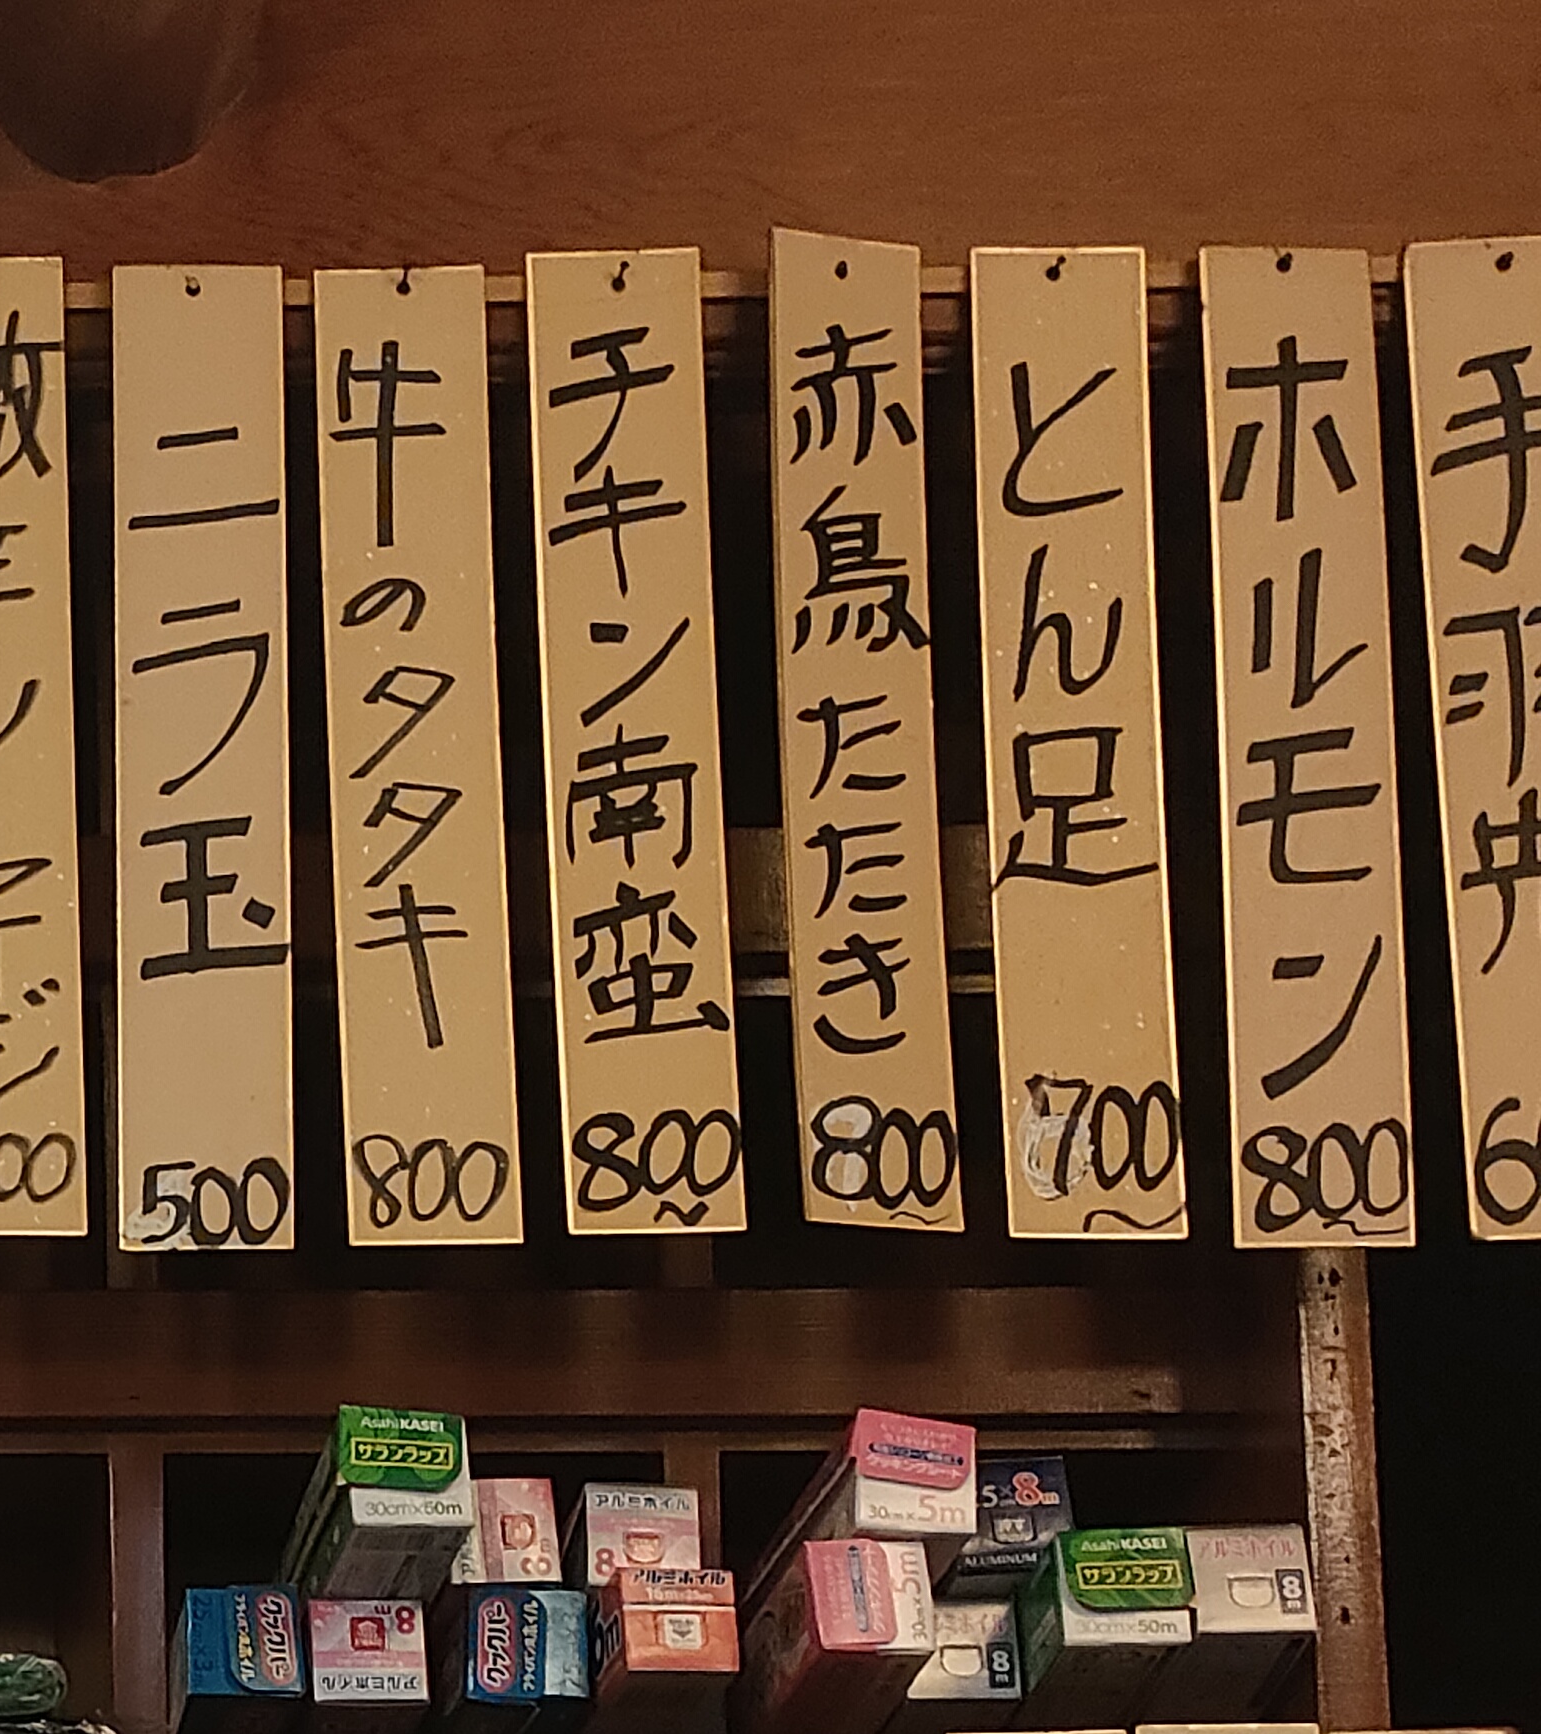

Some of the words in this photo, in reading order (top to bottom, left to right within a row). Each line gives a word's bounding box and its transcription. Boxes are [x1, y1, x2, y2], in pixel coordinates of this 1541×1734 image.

[129, 425, 290, 979] ニラ玉
[330, 341, 469, 1049] 牛のタタキ
[547, 325, 730, 1044] チキン南蛮
[789, 324, 932, 1054] 赤鳥たたき
[991, 361, 1159, 891] とん足
[1219, 335, 1383, 1099] ホルモン
[139, 1158, 288, 1247] 500
[352, 1133, 508, 1229] 800
[358, 1444, 448, 1464] サランラップ
[595, 1493, 691, 1511] アルミホイル
[1082, 1566, 1175, 1584] サランラップ
